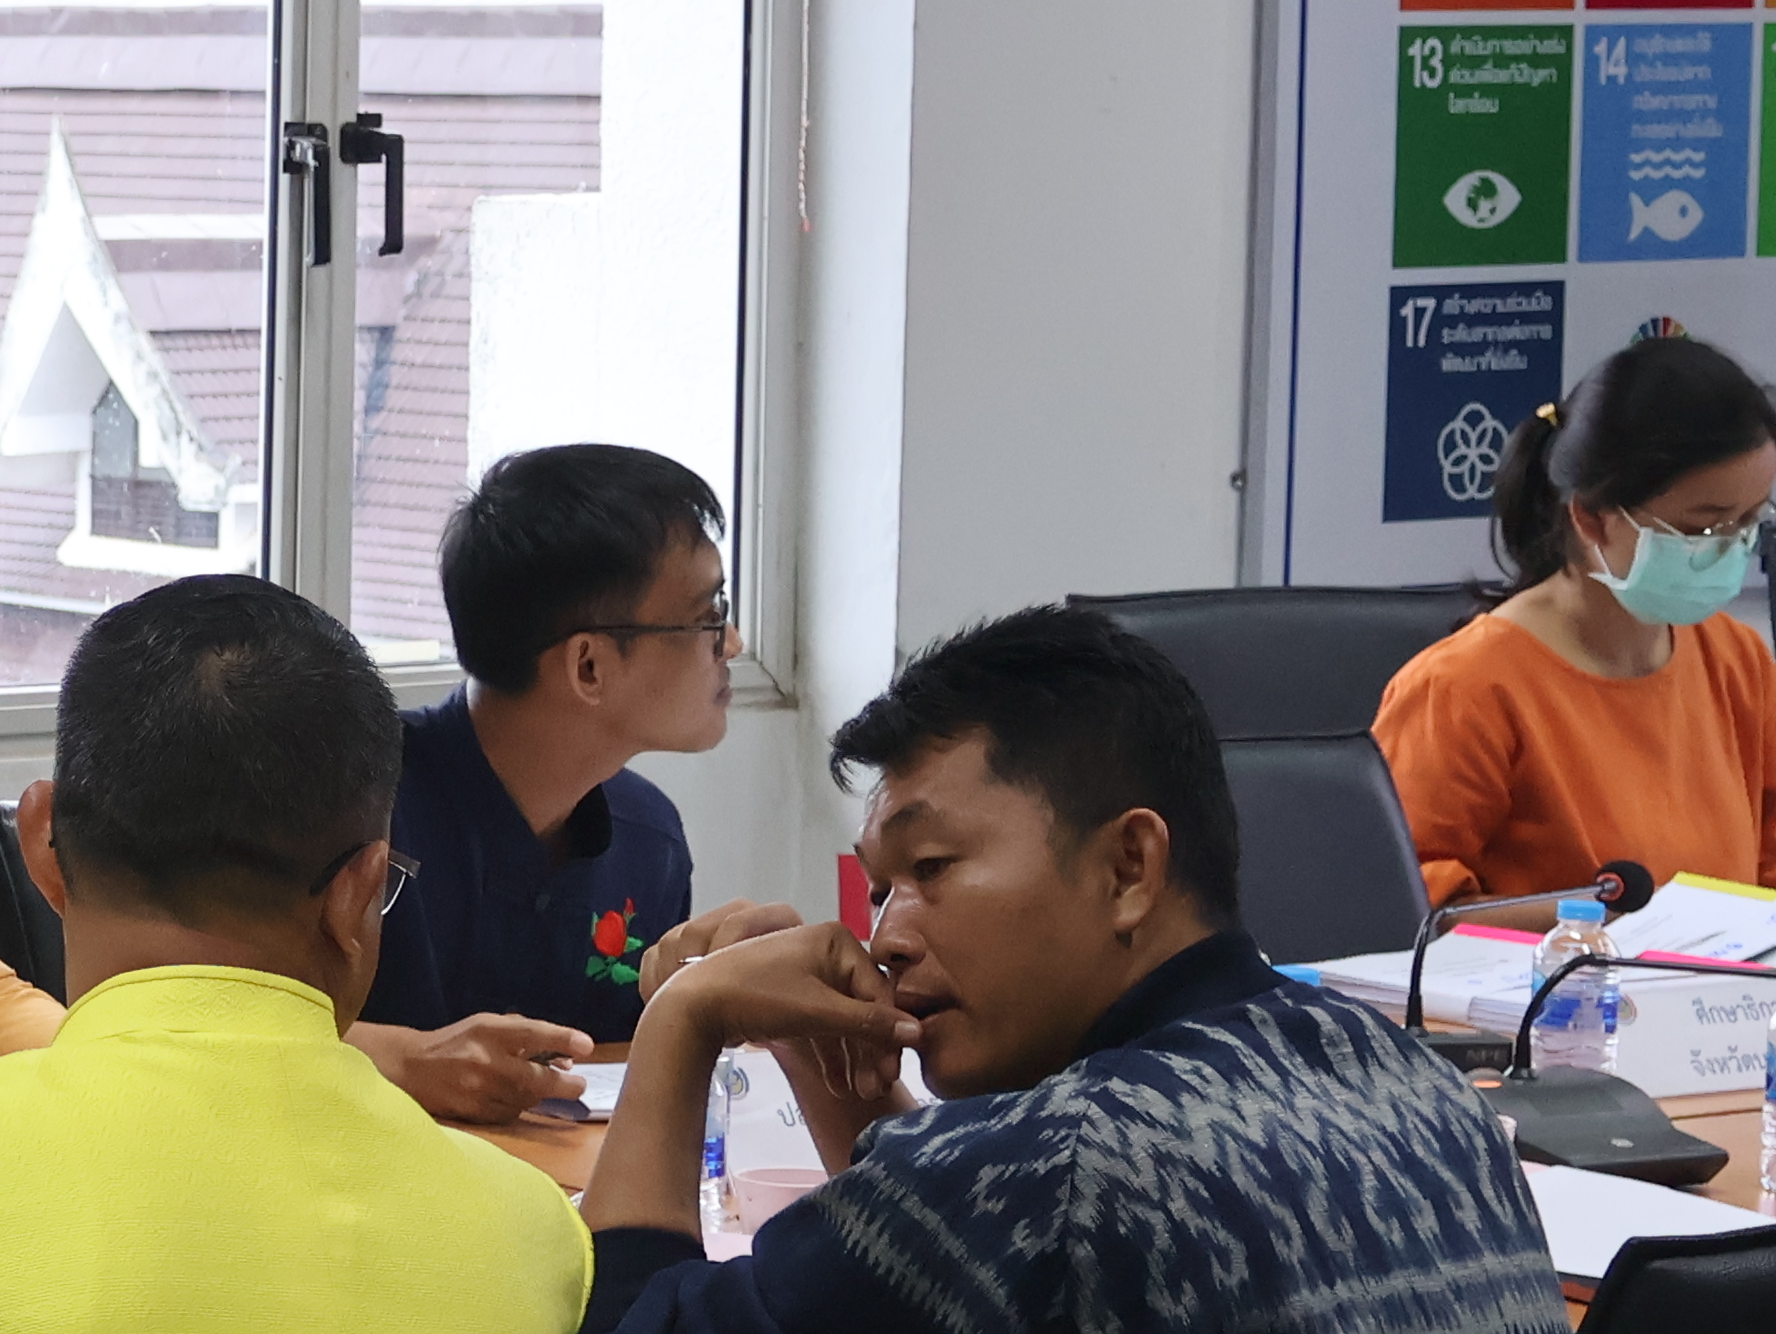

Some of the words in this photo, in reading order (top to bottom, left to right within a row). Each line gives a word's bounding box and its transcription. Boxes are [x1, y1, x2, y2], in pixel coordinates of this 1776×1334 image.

[1406, 36, 1444, 90] 13
[1593, 34, 1629, 86] 14
[1399, 296, 1437, 348] 17
